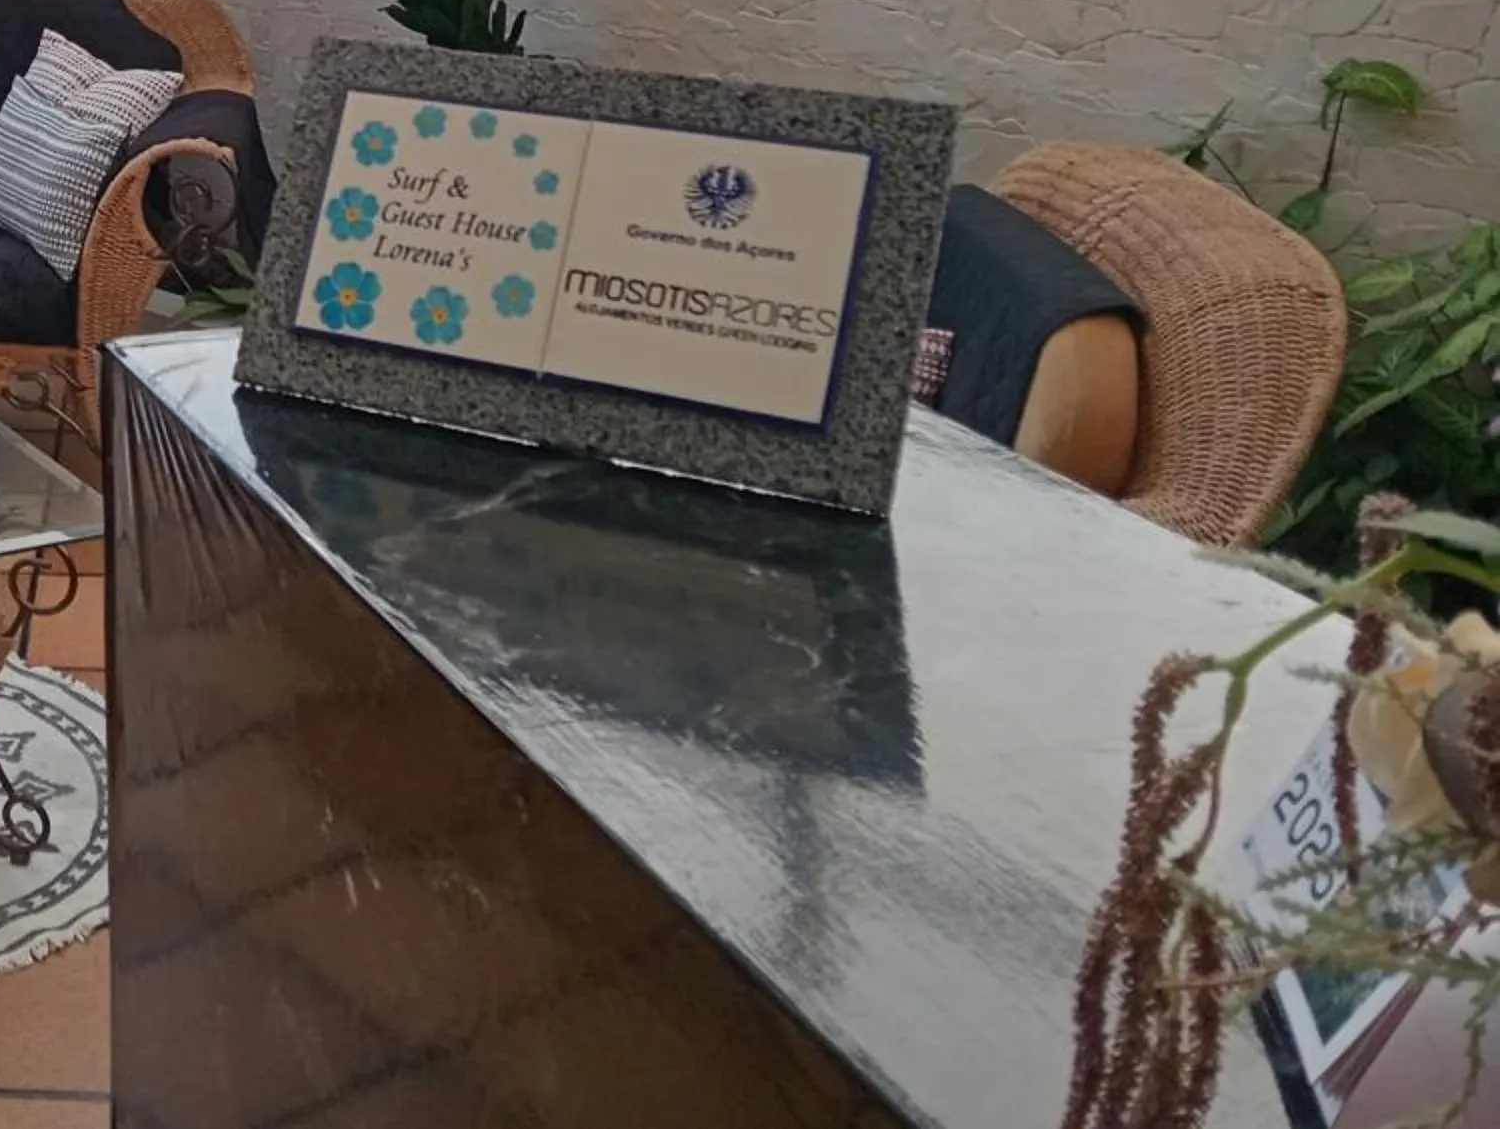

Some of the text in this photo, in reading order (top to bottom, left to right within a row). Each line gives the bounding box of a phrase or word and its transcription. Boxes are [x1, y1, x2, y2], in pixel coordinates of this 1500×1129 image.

[387, 166, 469, 204] Surf &
[381, 201, 527, 243] Guest House
[373, 234, 474, 272] Lorena's
[627, 224, 796, 262] Governo dos Açores
